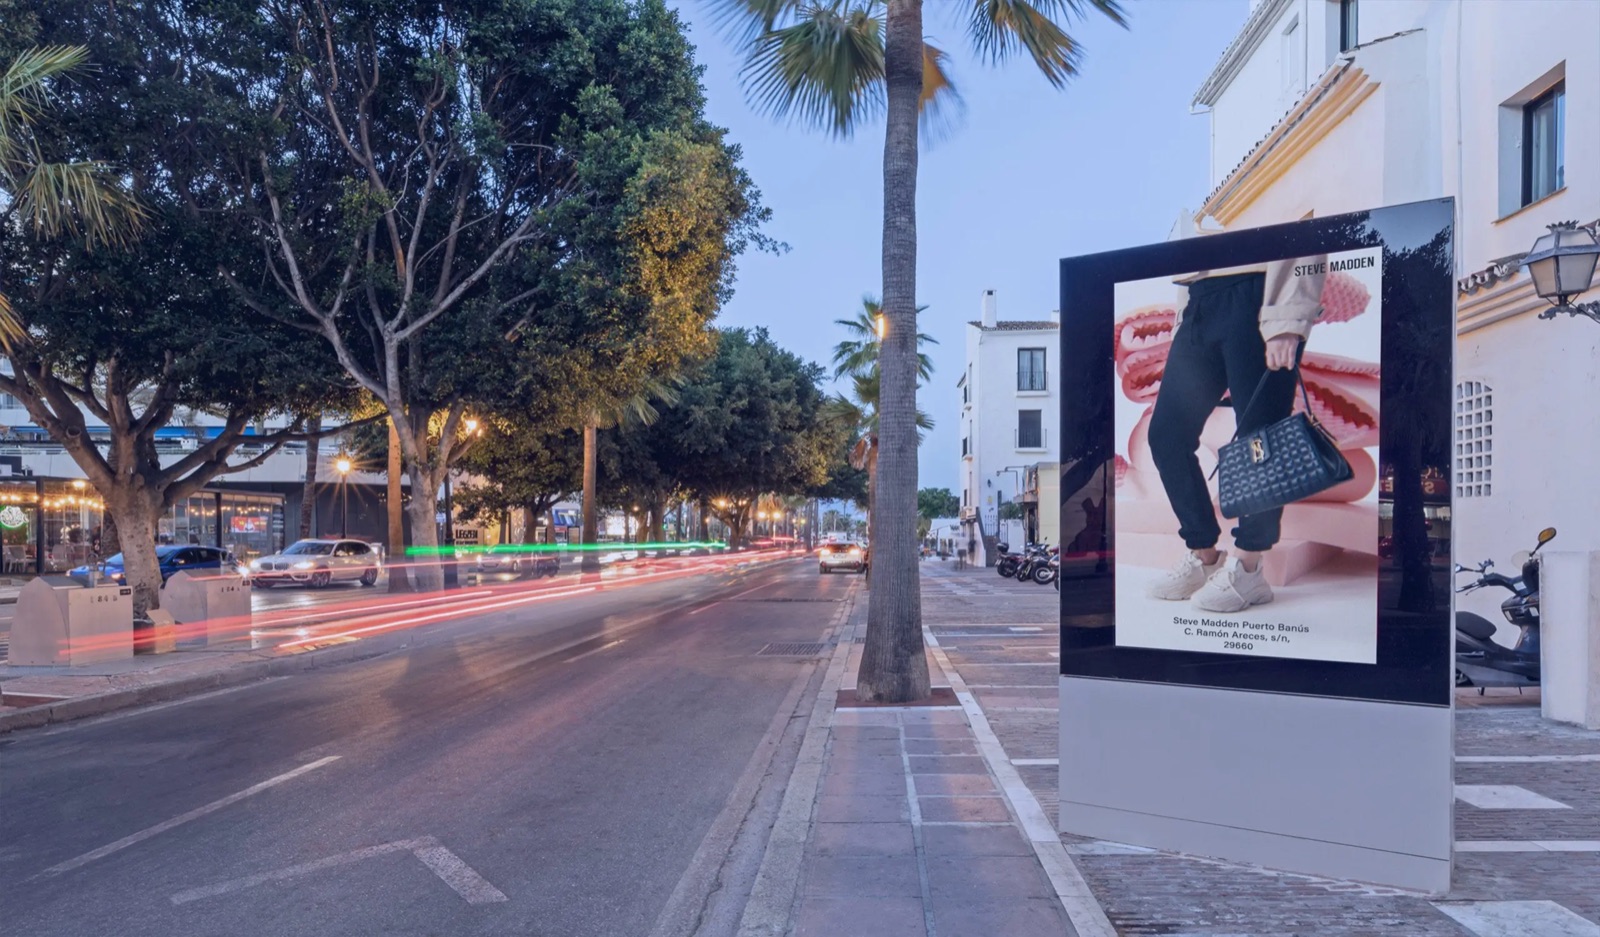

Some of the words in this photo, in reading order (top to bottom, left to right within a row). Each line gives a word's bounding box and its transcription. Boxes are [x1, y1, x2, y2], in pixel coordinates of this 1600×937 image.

[1294, 262, 1326, 277] STEVE
[1330, 256, 1375, 272] MADDEN
[1173, 616, 1199, 626] Steve
[1201, 618, 1240, 628] Madden
[1242, 621, 1275, 631] Puerto
[1278, 623, 1310, 633] Banús
[1184, 628, 1194, 636] C.
[1196, 628, 1229, 638] Ramón
[1232, 632, 1268, 642] Areces,
[1270, 634, 1291, 644] s/n,
[1223, 641, 1254, 650] 29660
